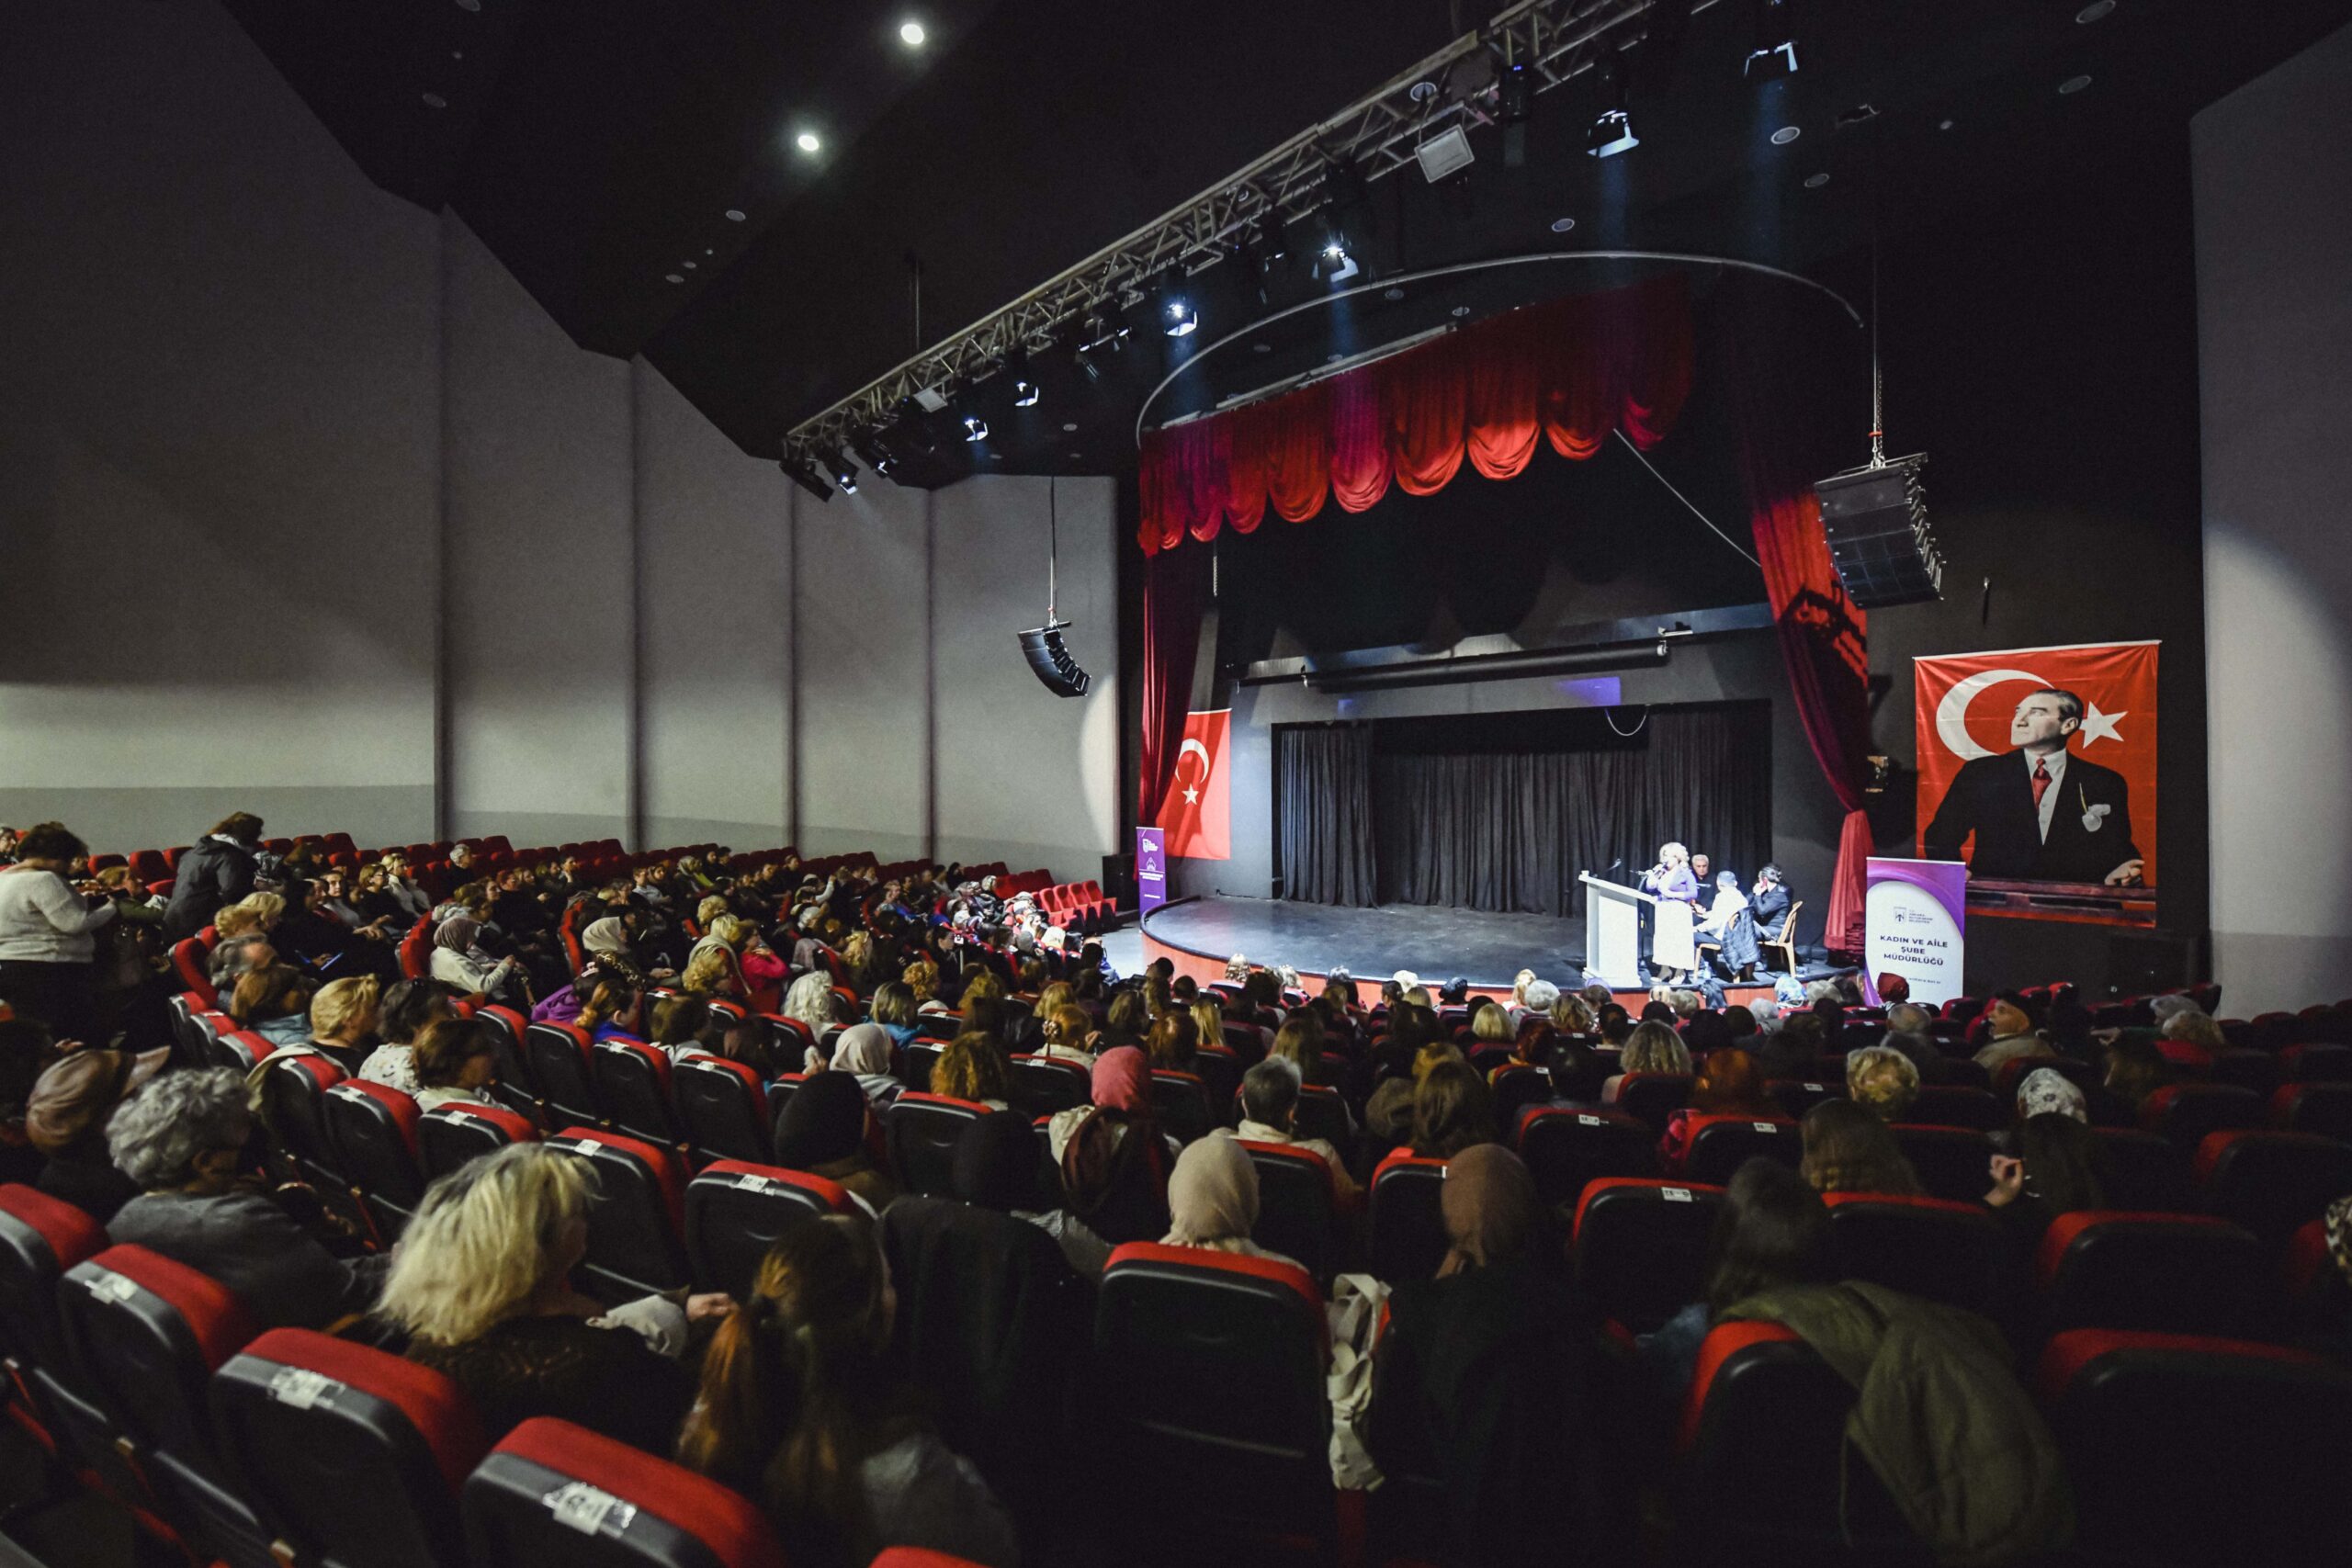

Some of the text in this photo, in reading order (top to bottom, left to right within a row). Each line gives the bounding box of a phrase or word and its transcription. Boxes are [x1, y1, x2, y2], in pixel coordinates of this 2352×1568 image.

[1880, 935, 1909, 943] KADIN
[1927, 938, 1948, 948] AİLE
[1901, 946, 1926, 954] ŞUBE
[1883, 953, 1944, 966] MÜDÜRLÜĞÜ
